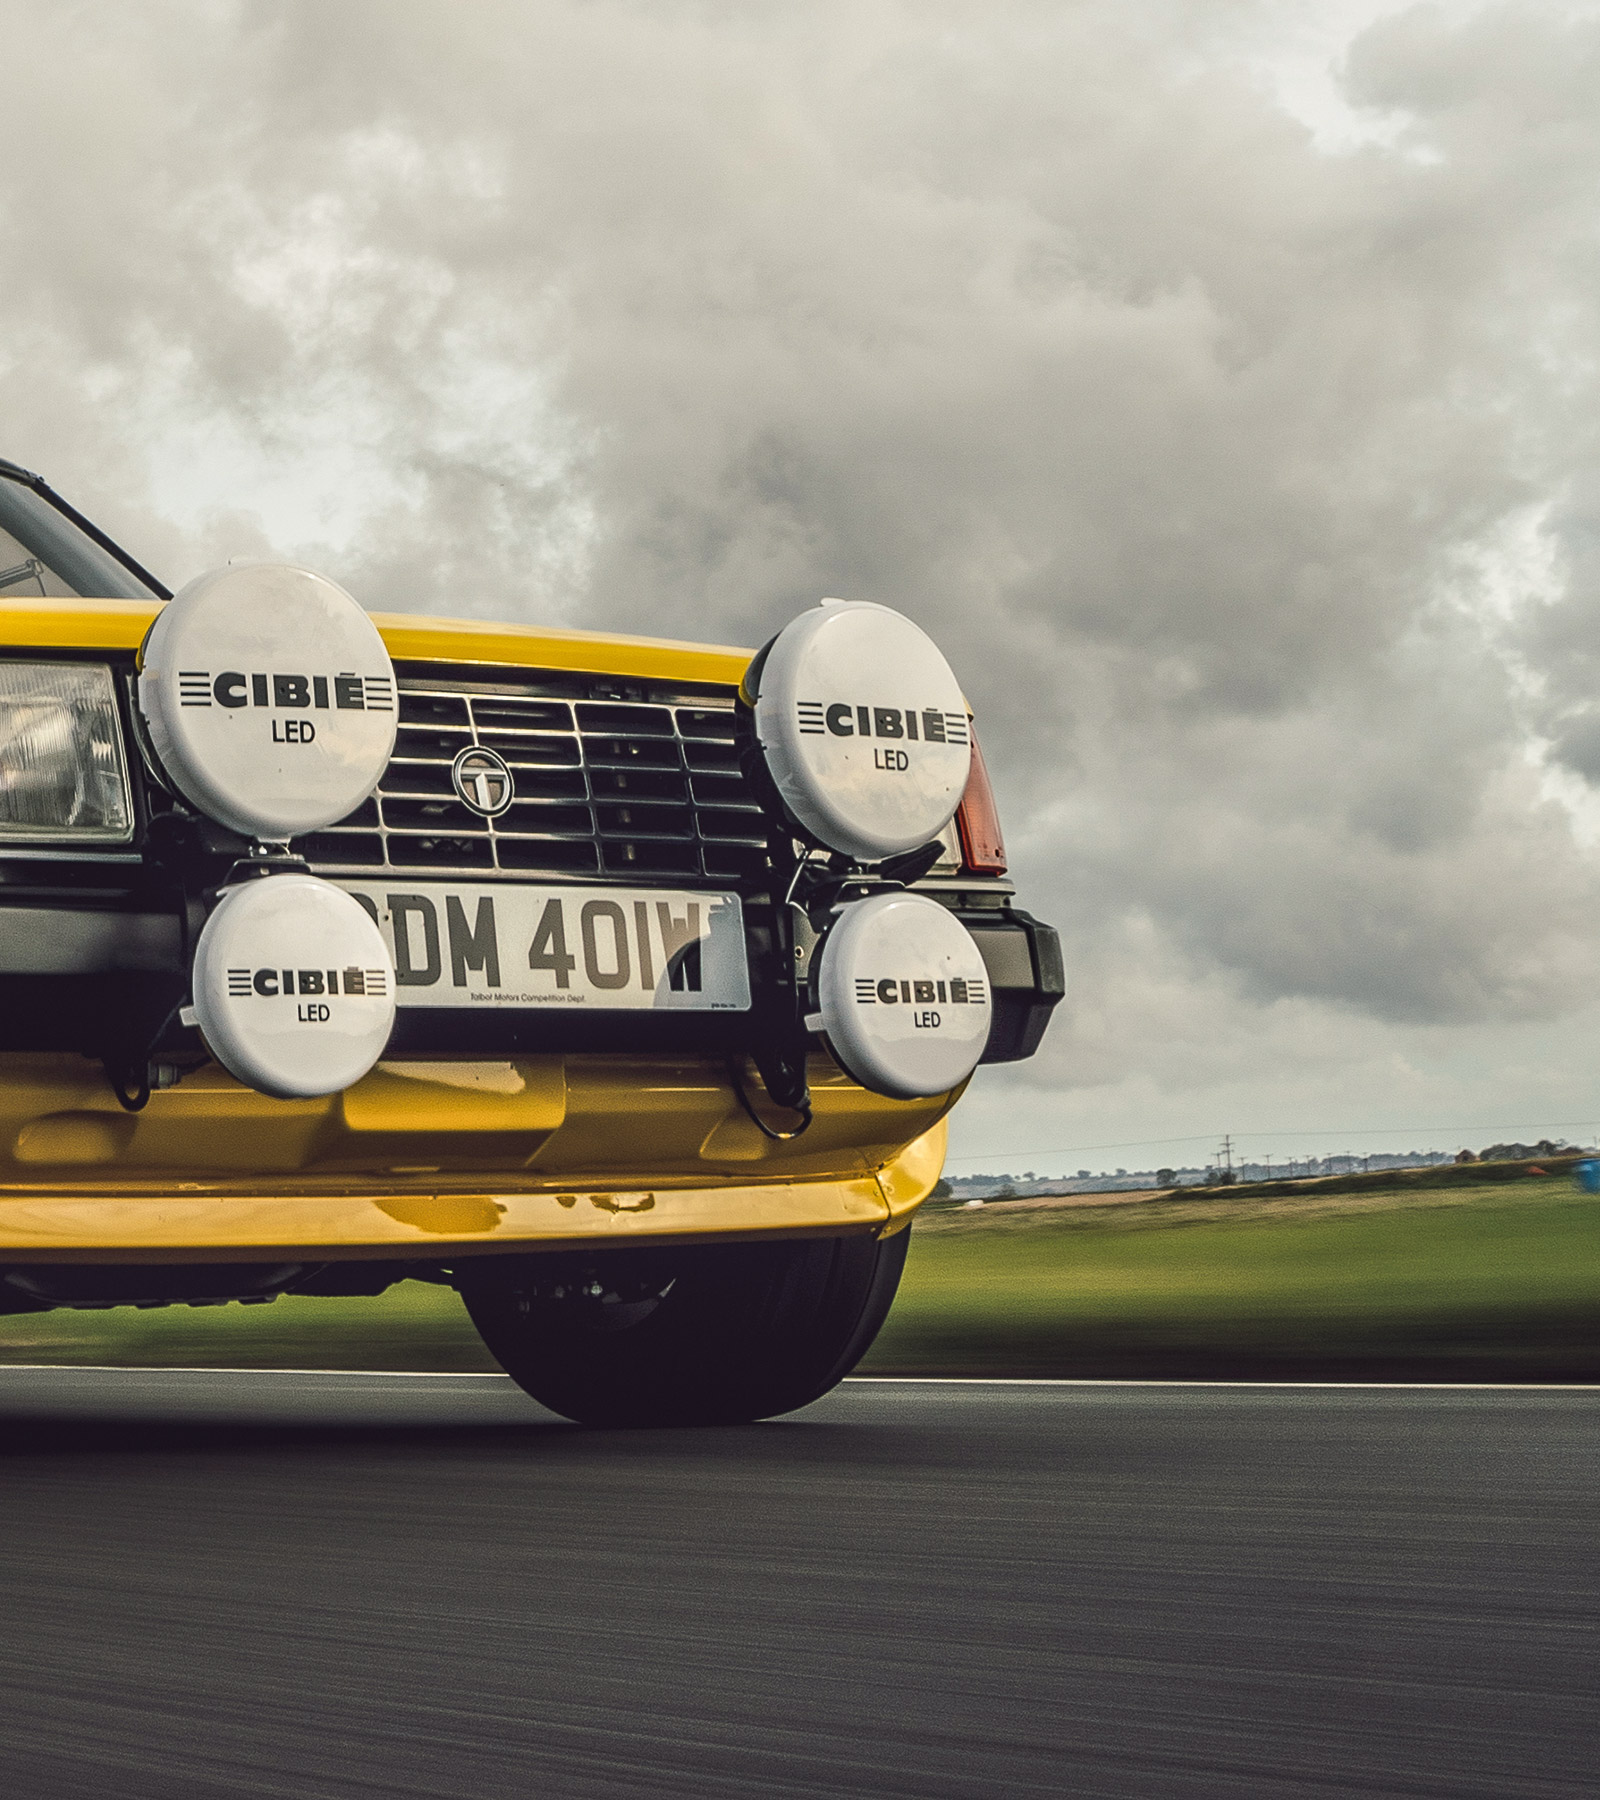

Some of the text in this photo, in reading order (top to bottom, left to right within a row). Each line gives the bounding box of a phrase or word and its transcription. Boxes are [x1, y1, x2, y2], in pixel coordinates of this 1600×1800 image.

[213, 671, 365, 711] CIBIÉ
[272, 719, 316, 743] LED
[825, 703, 947, 744] CIBIÉ
[874, 748, 909, 772] LED
[348, 893, 702, 992] DM 401W
[253, 966, 366, 996] CIBIÉ
[877, 977, 969, 1005] CIBIÉ
[470, 993, 493, 1001] Talbot
[494, 993, 519, 1002] Motors
[520, 993, 566, 1003] Competition
[298, 1004, 331, 1023] LED
[914, 1011, 941, 1029] LED
